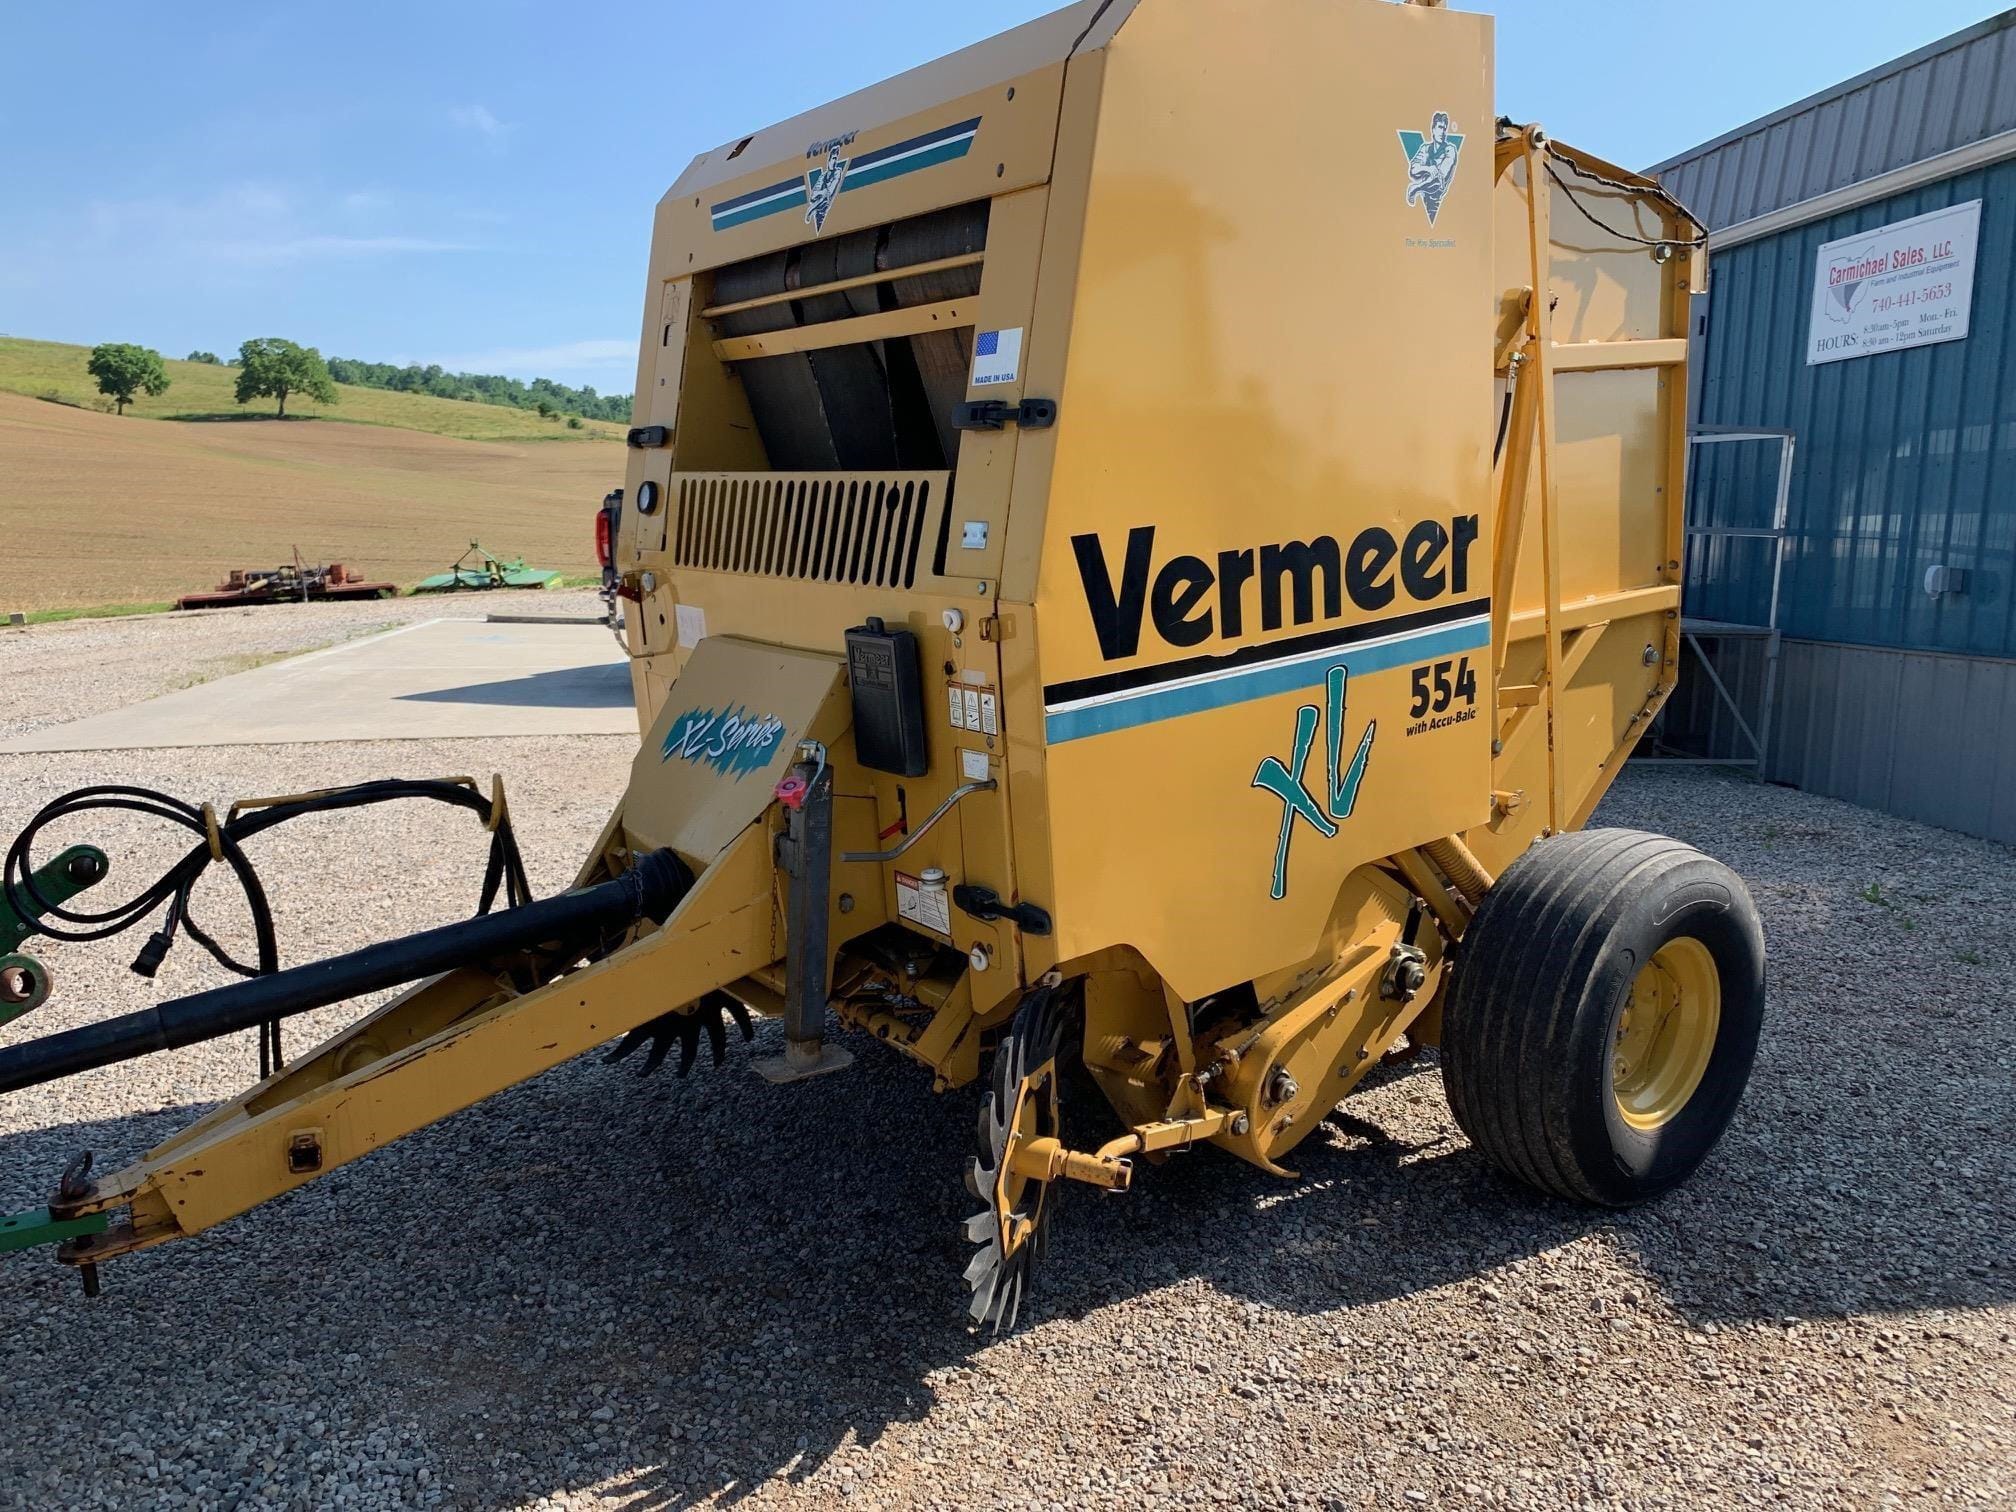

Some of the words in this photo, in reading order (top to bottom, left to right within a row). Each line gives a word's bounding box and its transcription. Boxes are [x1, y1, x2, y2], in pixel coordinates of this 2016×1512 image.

[806, 129, 860, 159] Vermeer
[1829, 253, 1889, 285] Carmichael
[1872, 282, 1952, 313] 740-441-5653
[1816, 332, 1859, 352] HOURS:
[1918, 324, 1952, 338] Saturday
[975, 375, 992, 384] MADE
[993, 374, 1000, 382] IN
[1001, 372, 1014, 381] USA
[1070, 513, 1479, 662] Vermeer
[1409, 656, 1476, 719] 554
[1406, 720, 1427, 737] with
[1428, 707, 1477, 731] Accu-Bale
